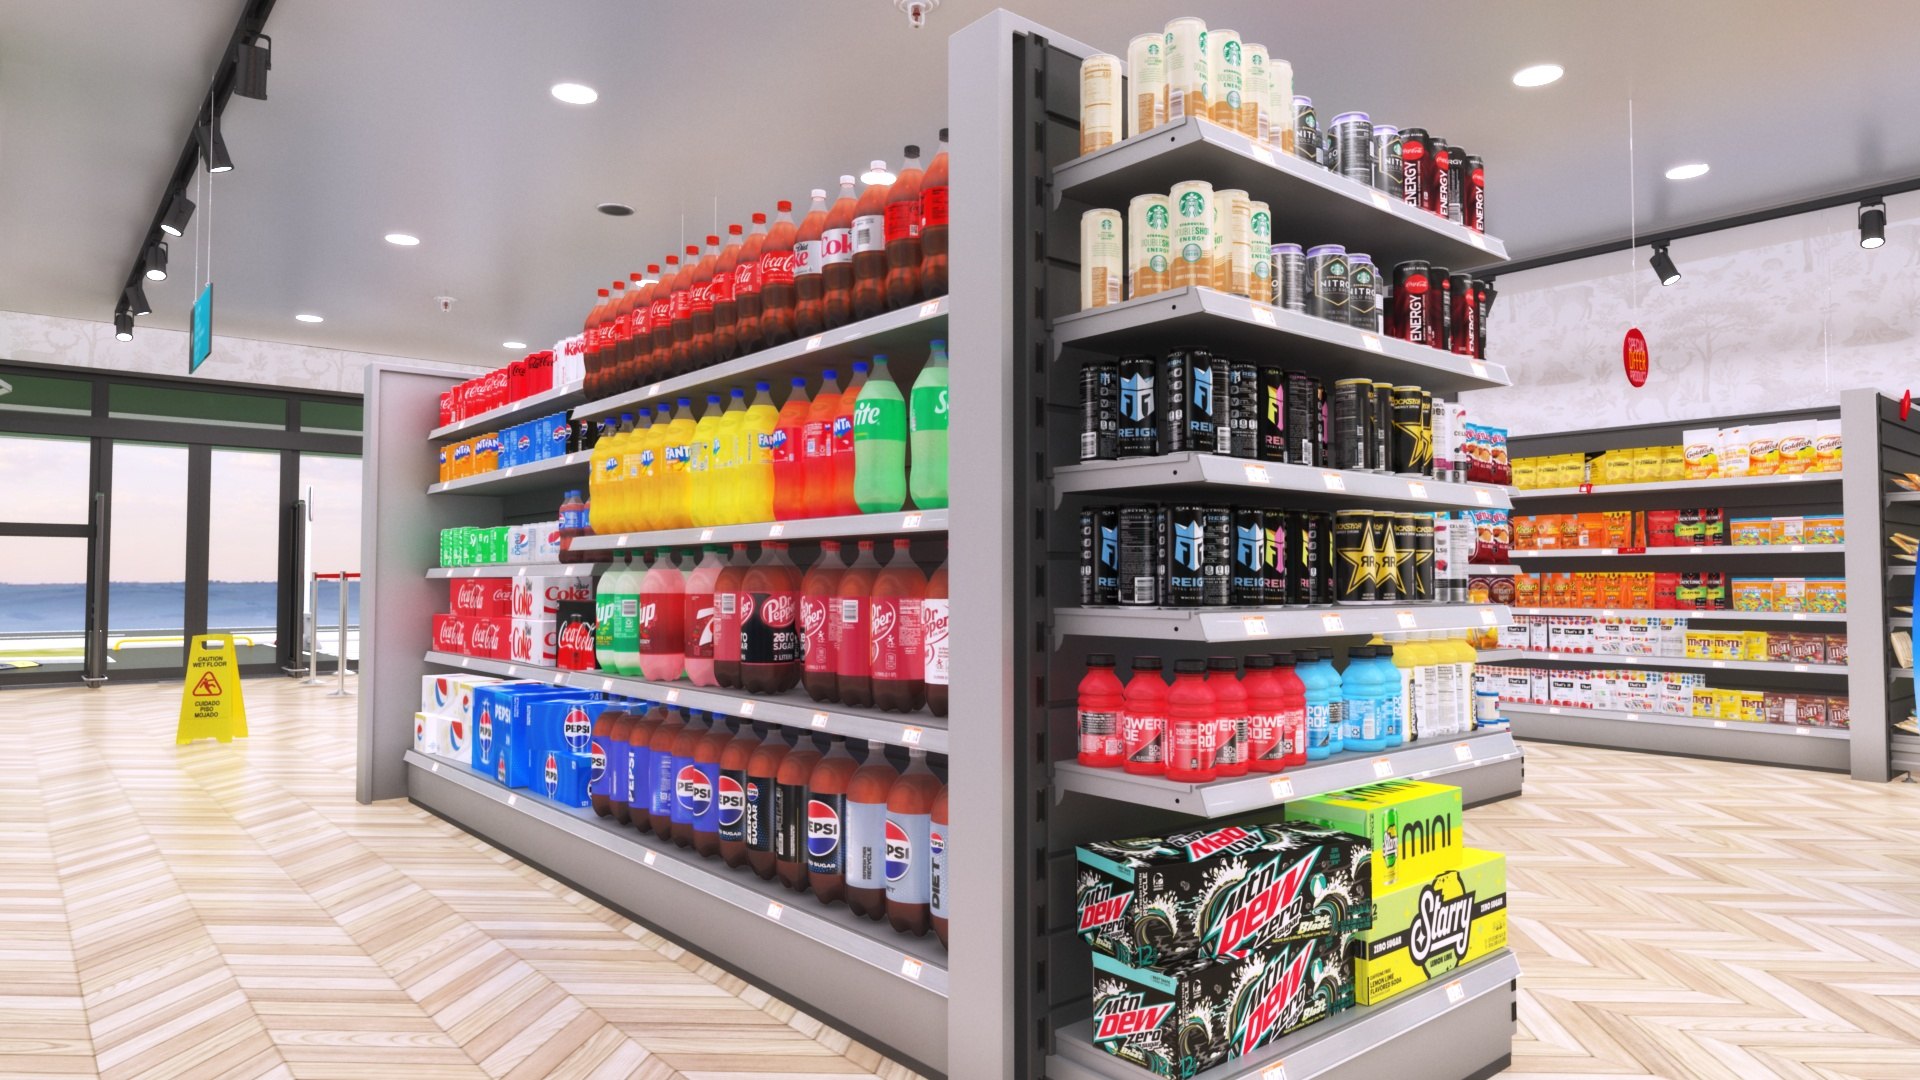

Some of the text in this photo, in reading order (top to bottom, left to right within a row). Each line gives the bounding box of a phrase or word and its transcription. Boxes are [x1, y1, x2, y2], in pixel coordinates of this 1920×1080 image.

[1405, 162, 1416, 207] ENERGY
[1476, 187, 1484, 231] ENERGY
[1410, 294, 1422, 342] ENERGY
[545, 586, 590, 601] Coke
[780, 596, 792, 608] Dr
[495, 705, 510, 724] PEPSI
[565, 724, 592, 734] PEPSI
[1402, 813, 1451, 860] mini
[932, 858, 940, 909] DIET
[1080, 885, 1110, 909] Mtn
[1217, 862, 1275, 926] Mtn
[1480, 898, 1503, 912] ZERO SUGAR
[1100, 919, 1124, 935] zero
[1256, 899, 1302, 945] zero
[1411, 890, 1474, 961] Starry
[1374, 936, 1402, 954] ZERO SUGAR
[1370, 973, 1394, 988] LEMON LIME
[1370, 982, 1390, 994] FLAVORED
[1099, 996, 1140, 1016] Mtn
[1128, 1030, 1162, 1044] zero
